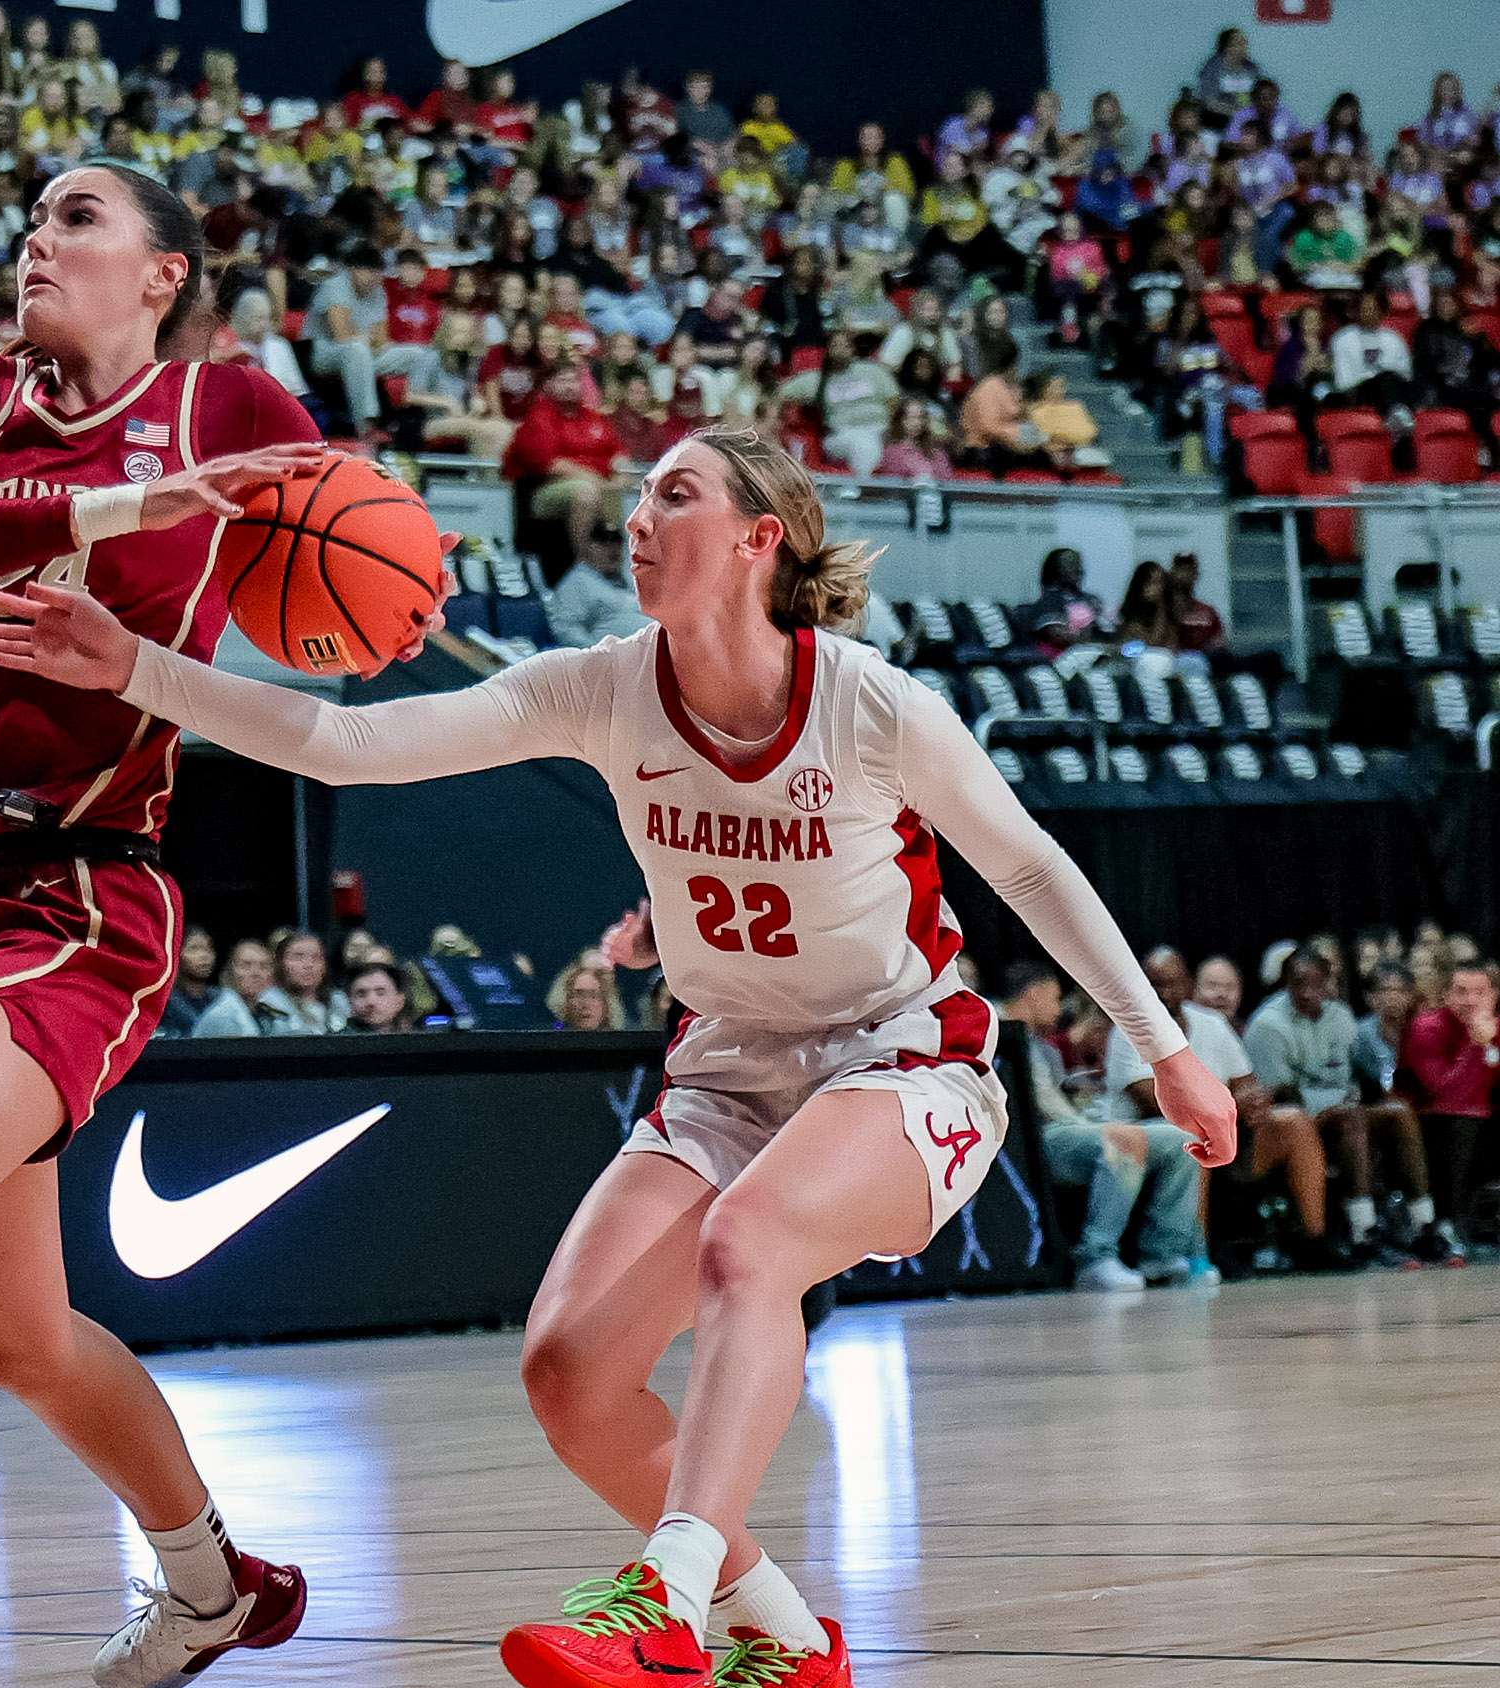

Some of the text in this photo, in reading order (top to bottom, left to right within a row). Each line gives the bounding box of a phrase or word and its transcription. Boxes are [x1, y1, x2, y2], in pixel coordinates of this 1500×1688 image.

[790, 770, 833, 811] SEC
[647, 803, 833, 862] ALABAMA
[687, 875, 799, 958] 22
